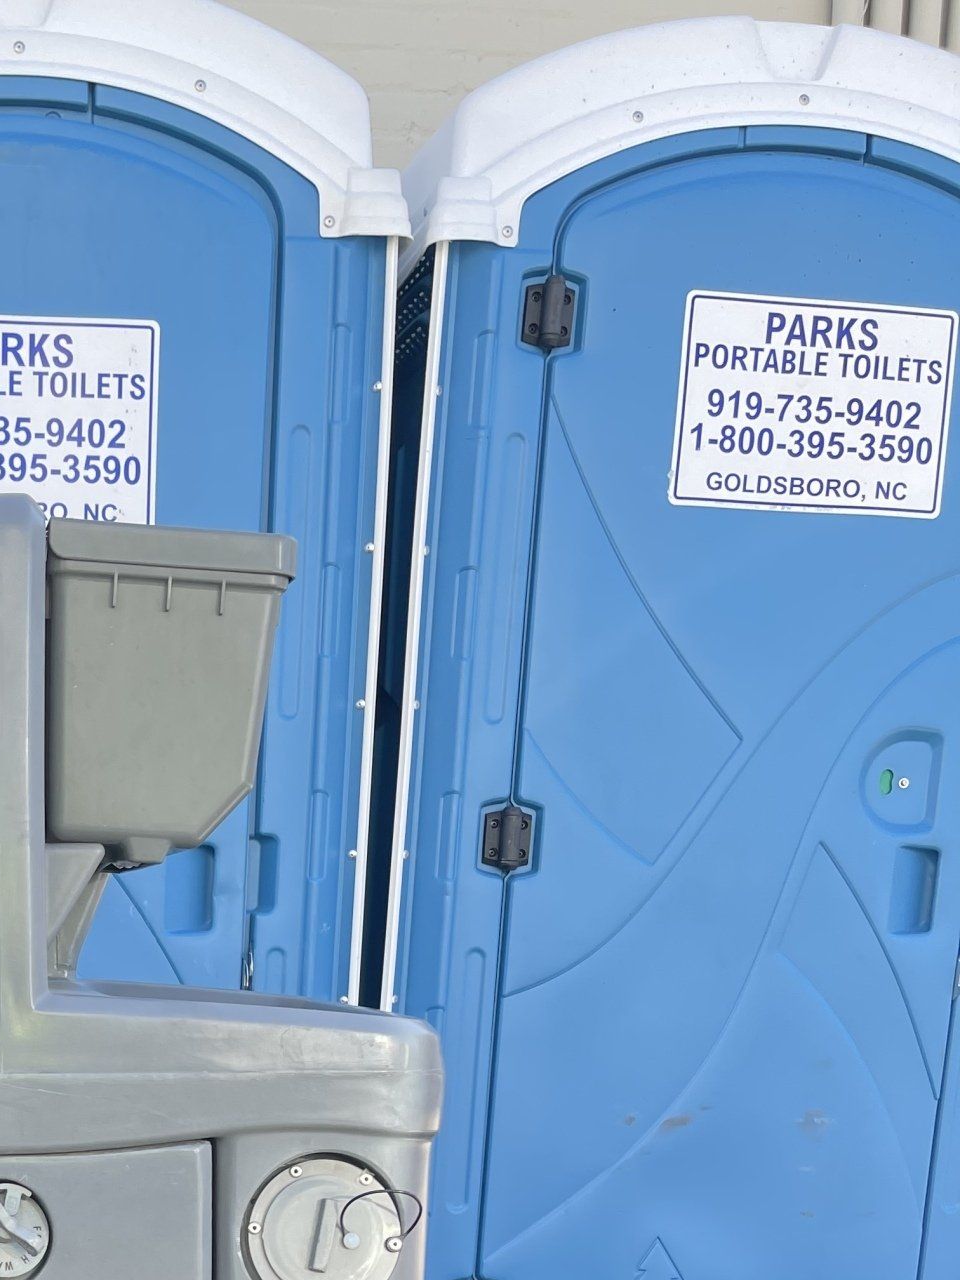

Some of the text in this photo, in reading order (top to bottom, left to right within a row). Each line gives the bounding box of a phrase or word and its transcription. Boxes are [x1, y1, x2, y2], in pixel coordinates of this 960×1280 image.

[765, 312, 879, 351] PARKS
[694, 342, 942, 385] PORTABLE TOILETS
[33, 371, 146, 400] TOILETS
[707, 388, 922, 430] 919-735-9402
[690, 422, 933, 465] 1-800-395-3590
[706, 471, 908, 502] GOLDSBORO, NC
[83, 503, 118, 522] NC
